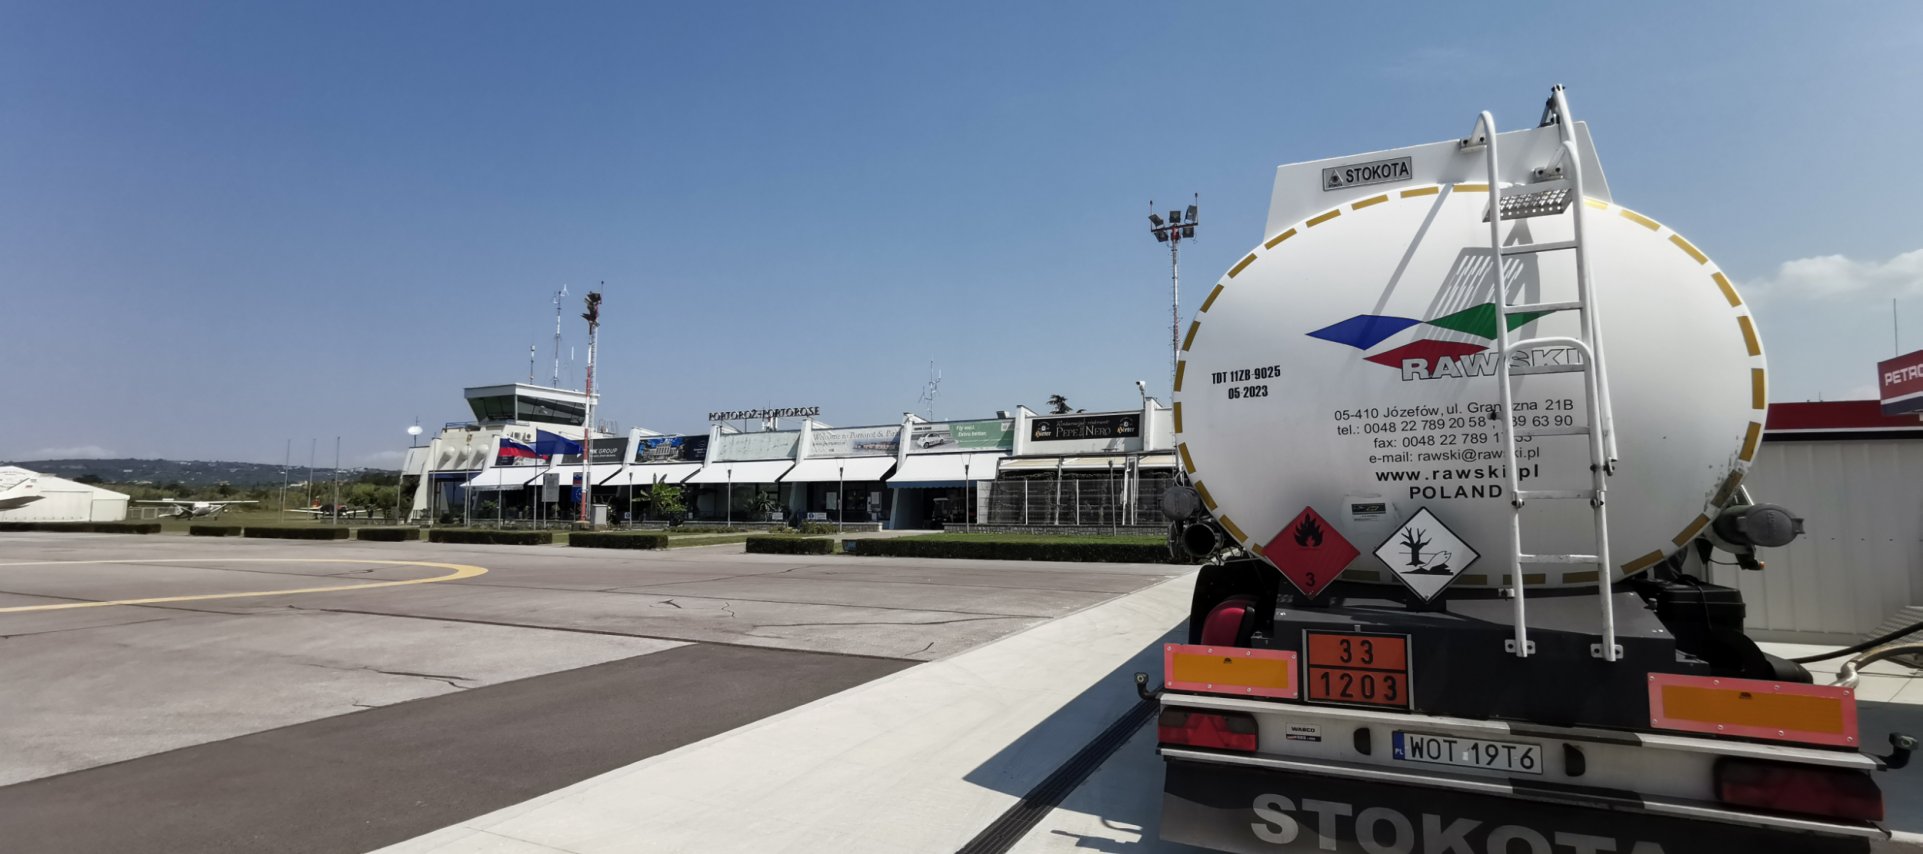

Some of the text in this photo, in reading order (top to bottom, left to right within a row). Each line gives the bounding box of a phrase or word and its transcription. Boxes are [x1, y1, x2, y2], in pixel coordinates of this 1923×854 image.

[1346, 161, 1409, 183] STOKOTA
[1211, 365, 1281, 385] TDT 11ZB-9025
[1402, 347, 1584, 382] RAWSKI
[1334, 399, 1573, 421] 05-410 Józefów, ul. Granzna 21B
[1337, 424, 1360, 435] tel.:
[1364, 422, 1396, 434] 0048
[1401, 420, 1417, 432] 22
[1421, 418, 1445, 430] 789
[1448, 417, 1465, 429] 20
[1468, 416, 1486, 428] 58
[1532, 415, 1549, 427] 63
[1554, 415, 1573, 426] 90
[1374, 437, 1397, 449] fax:
[1402, 435, 1435, 448] 0048
[1440, 434, 1457, 445] 22
[1462, 433, 1487, 444] 789
[1369, 447, 1540, 464] e-mail: rawski@rawki.pl
[1375, 464, 1539, 481] www.rawskipl
[1409, 484, 1503, 499] POLAND
[1305, 572, 1316, 588] 3
[1339, 638, 1374, 665] 33
[1320, 671, 1397, 701] 1203
[1410, 736, 1534, 770] WOT 19T6
[1251, 793, 1665, 854] STOKOT
